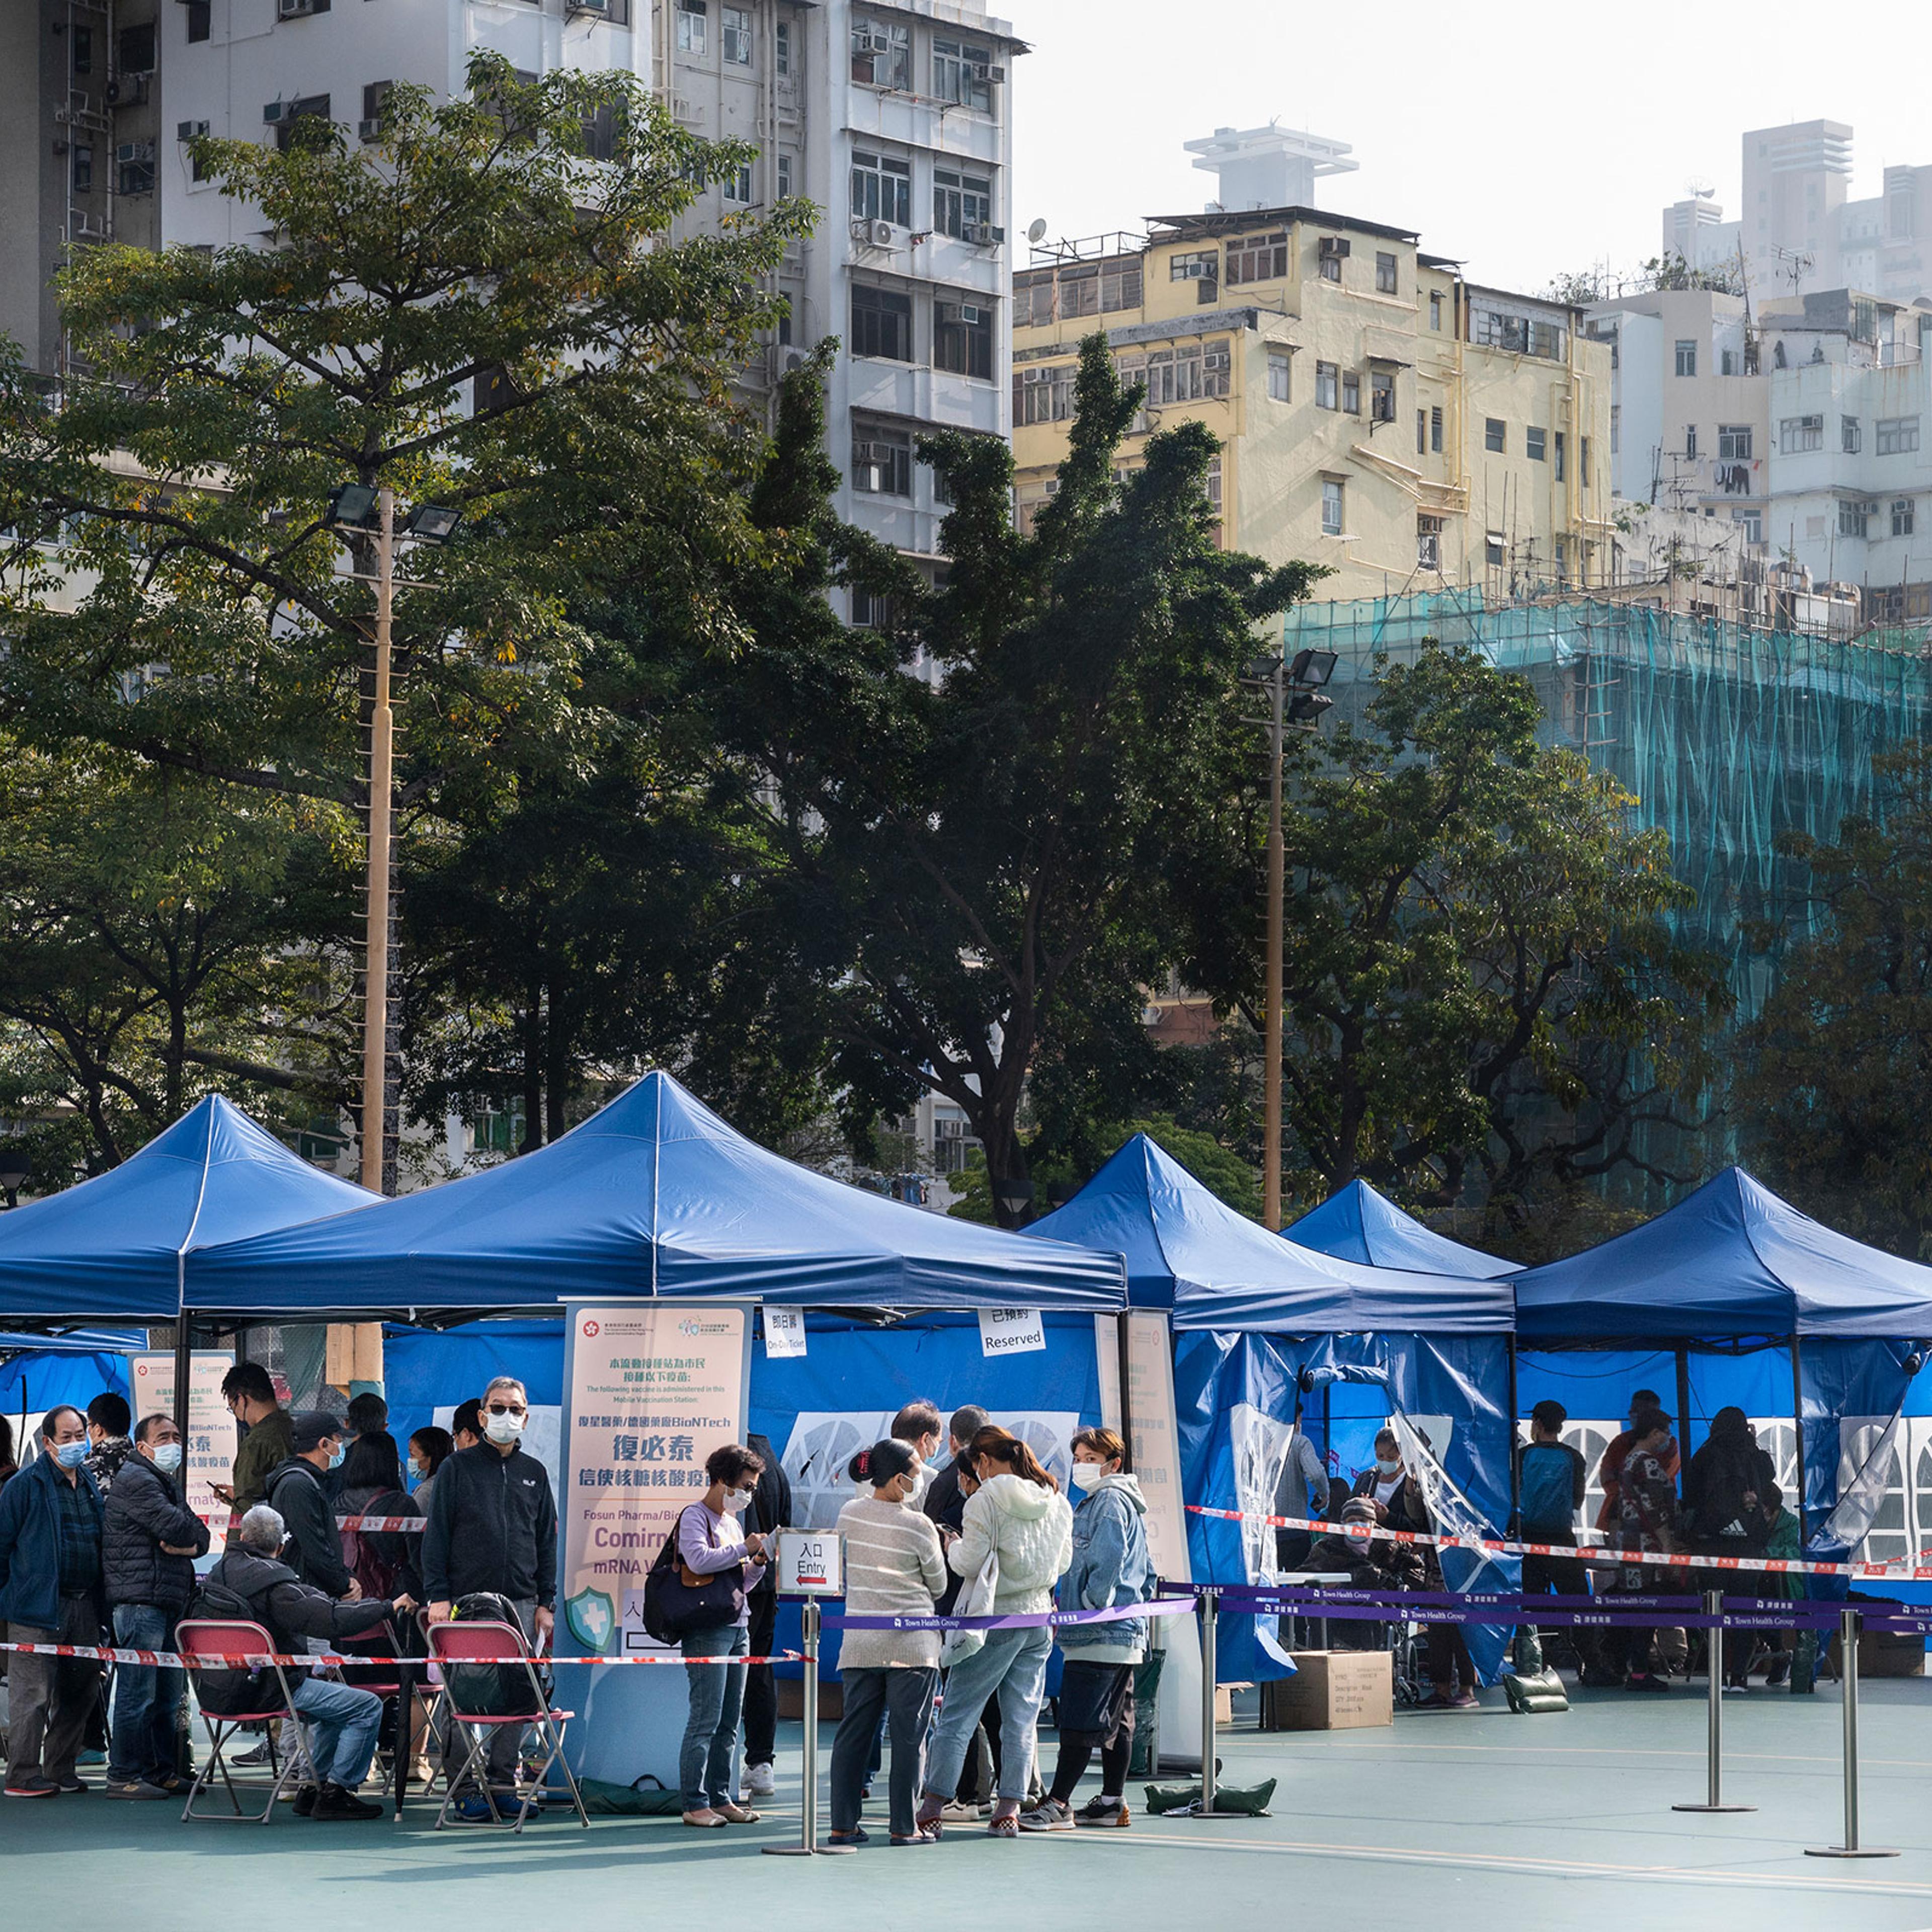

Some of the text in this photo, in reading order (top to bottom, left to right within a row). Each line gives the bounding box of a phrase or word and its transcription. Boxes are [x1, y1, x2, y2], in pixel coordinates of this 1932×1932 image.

[991, 1309, 1028, 1323] 已預約
[986, 1330, 1040, 1348] Reserved
[613, 1435, 694, 1461] 復必泰
[584, 1510, 615, 1520] Fosun
[800, 1543, 823, 1558] 入口
[594, 1559, 642, 1574] mRNA
[797, 1560, 826, 1578] Entry
[1427, 1611, 1446, 1619] Health
[1447, 1612, 1467, 1622] Group
[1734, 1617, 1796, 1627] Town Health Group
[904, 1619, 960, 1629] Town Health Group
